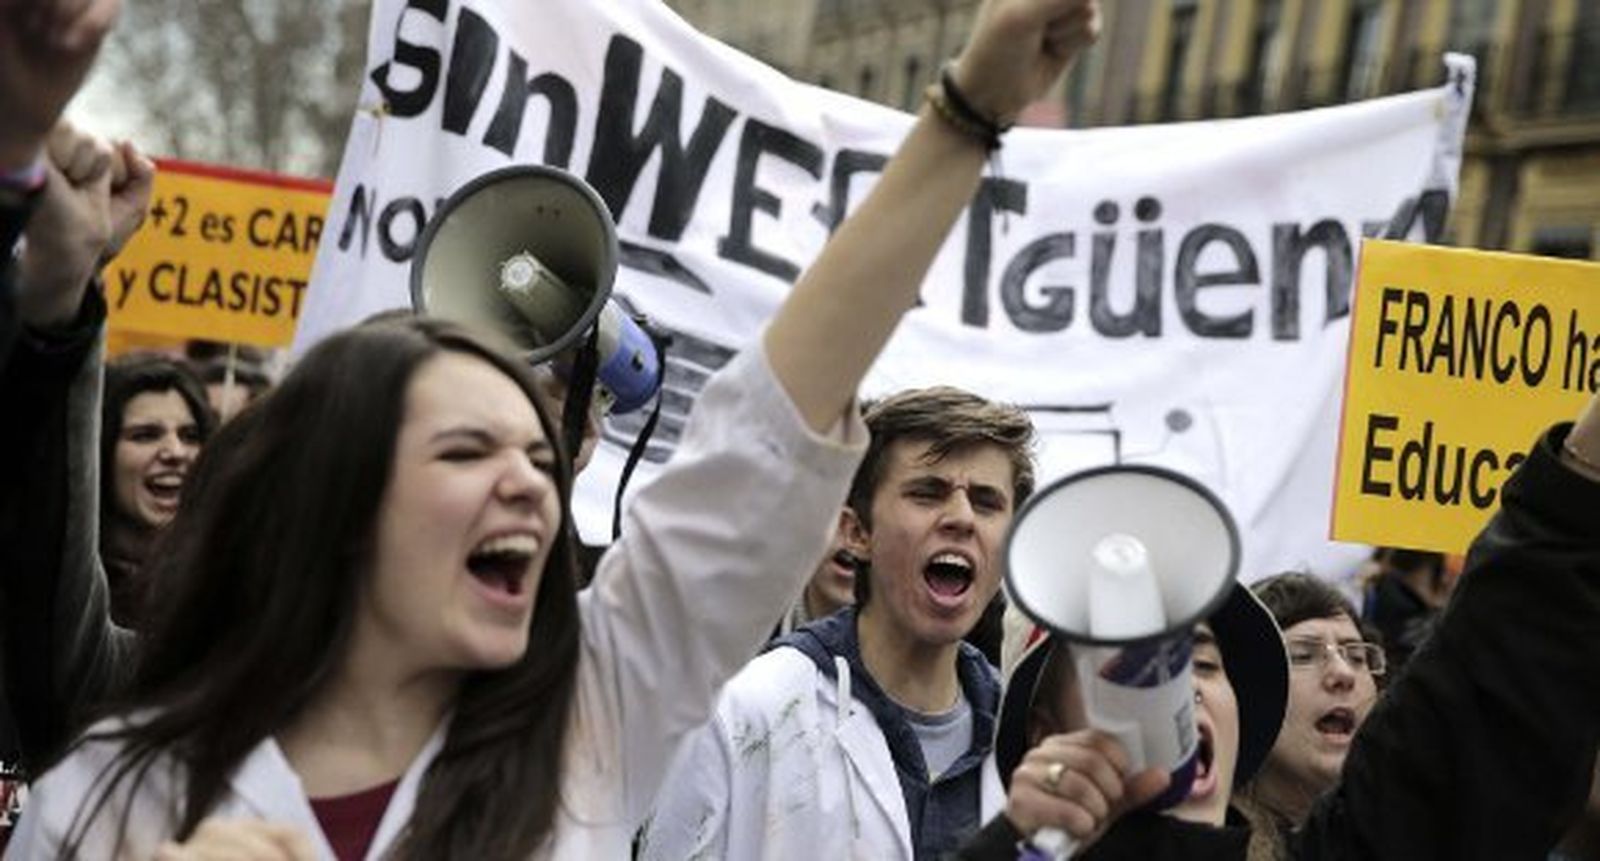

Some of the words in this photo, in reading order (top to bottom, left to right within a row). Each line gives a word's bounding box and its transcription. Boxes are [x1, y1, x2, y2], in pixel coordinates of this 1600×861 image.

[151, 197, 188, 237] +2
[200, 213, 235, 242] es
[247, 208, 324, 252] CAR
[338, 182, 452, 263] NO
[116, 268, 136, 309] y
[148, 263, 308, 318] CLASIST
[1374, 287, 1552, 387] FRANCO
[1361, 413, 1526, 509] Educ
